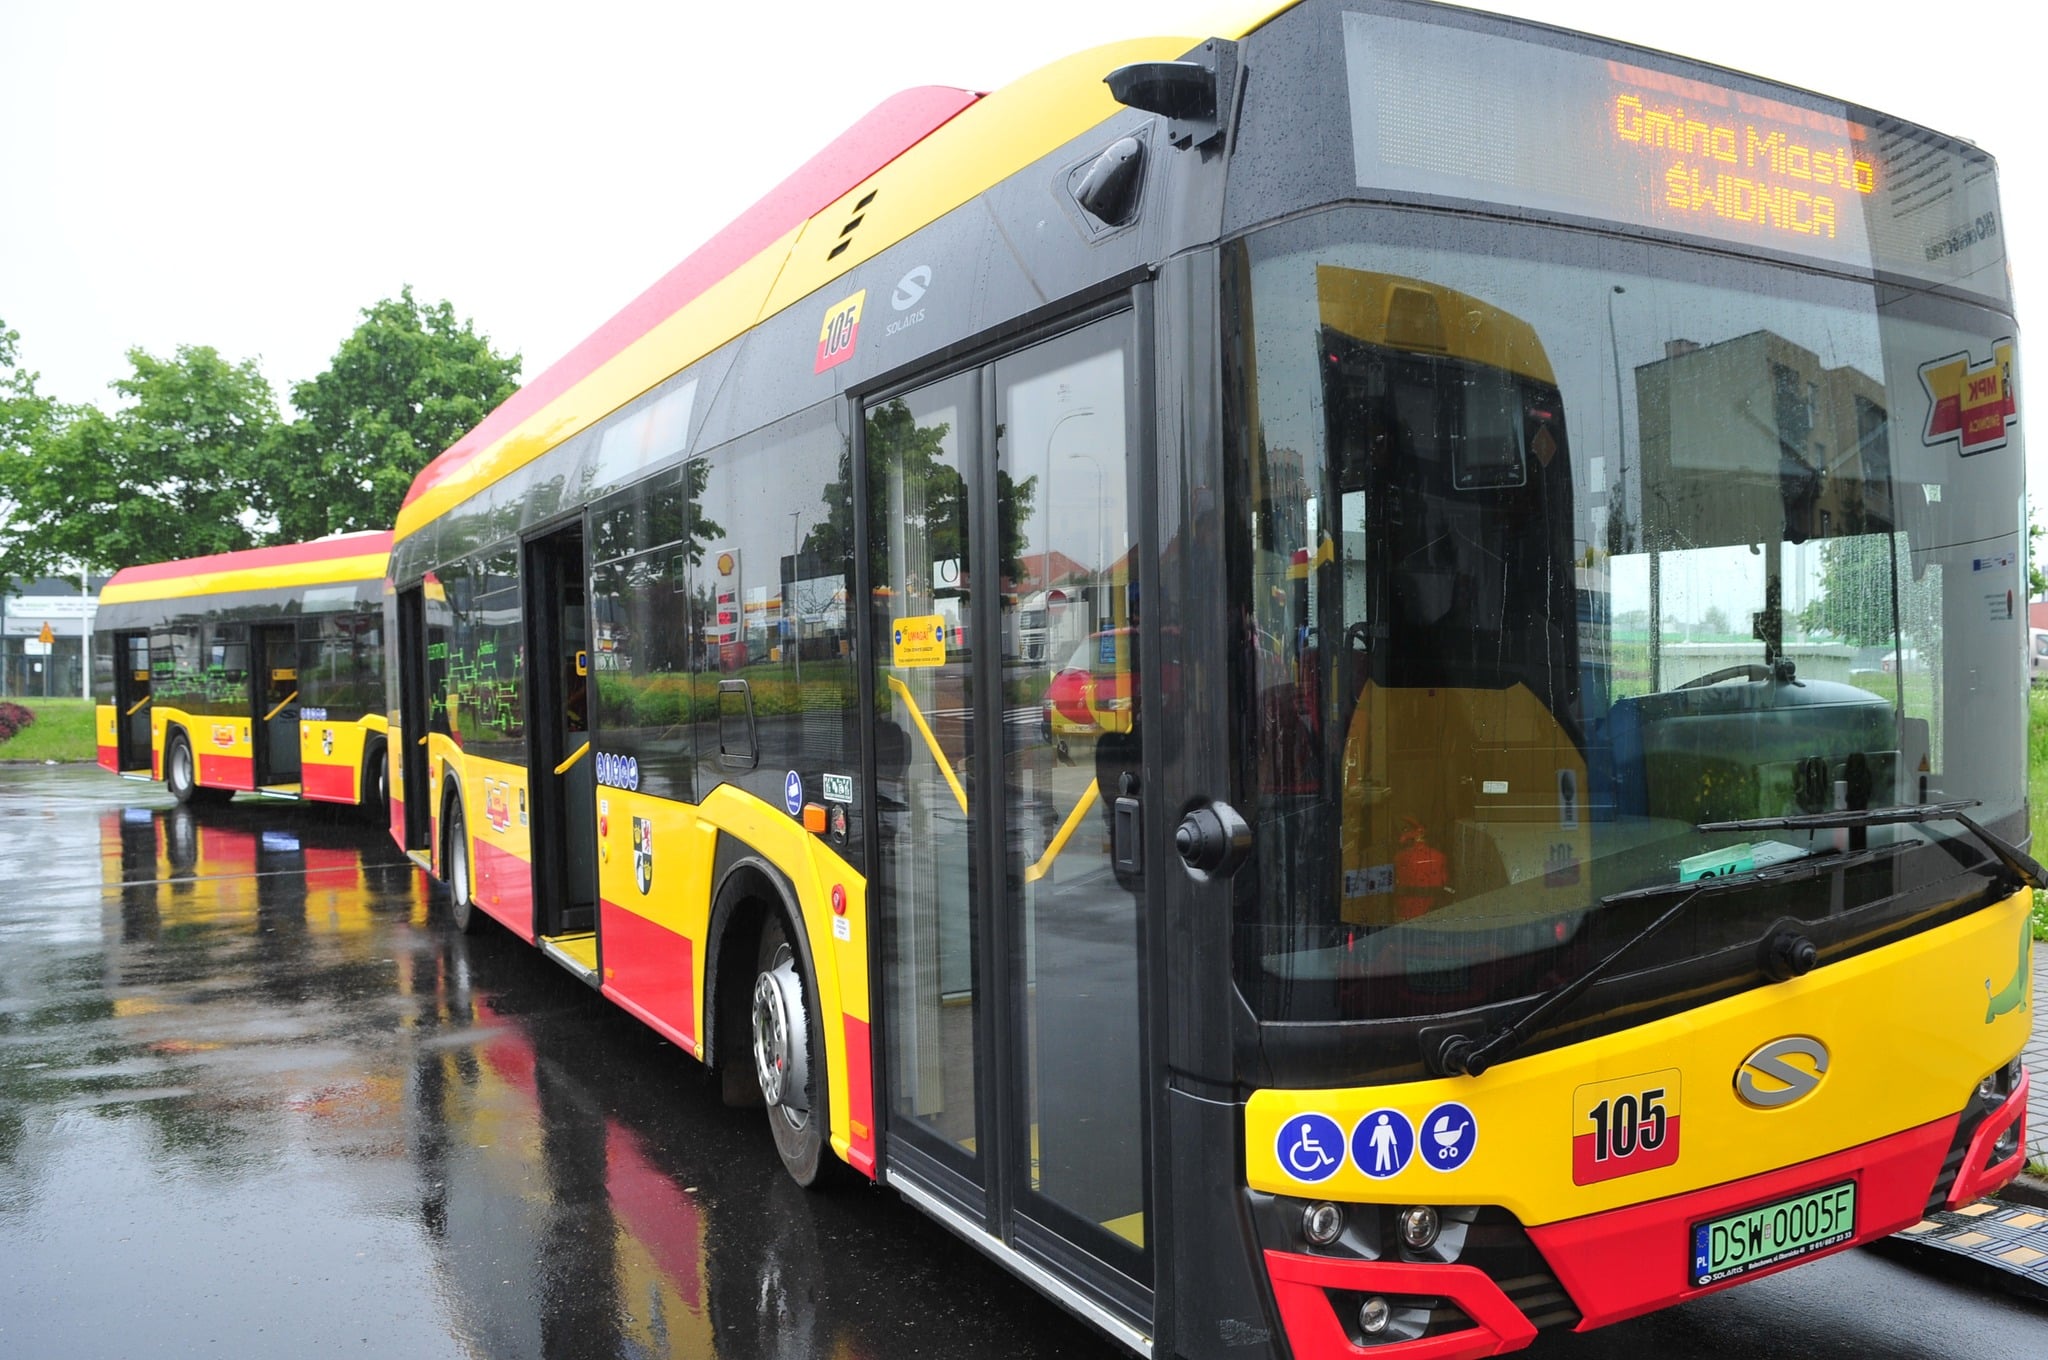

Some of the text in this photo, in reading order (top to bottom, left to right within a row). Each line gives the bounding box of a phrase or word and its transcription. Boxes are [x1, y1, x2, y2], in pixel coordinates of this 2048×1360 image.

[1616, 93, 1874, 194] Gmina Miasto
[1665, 160, 1836, 239] ŚWIDNICA
[822, 304, 857, 359] 105
[884, 307, 926, 338] SOLARIS
[1588, 1087, 1666, 1162] 105
[1711, 1188, 1850, 1268] DSW 0005F
[1696, 1255, 1708, 1270] PL
[1711, 1264, 1744, 1281] SOLARIS
